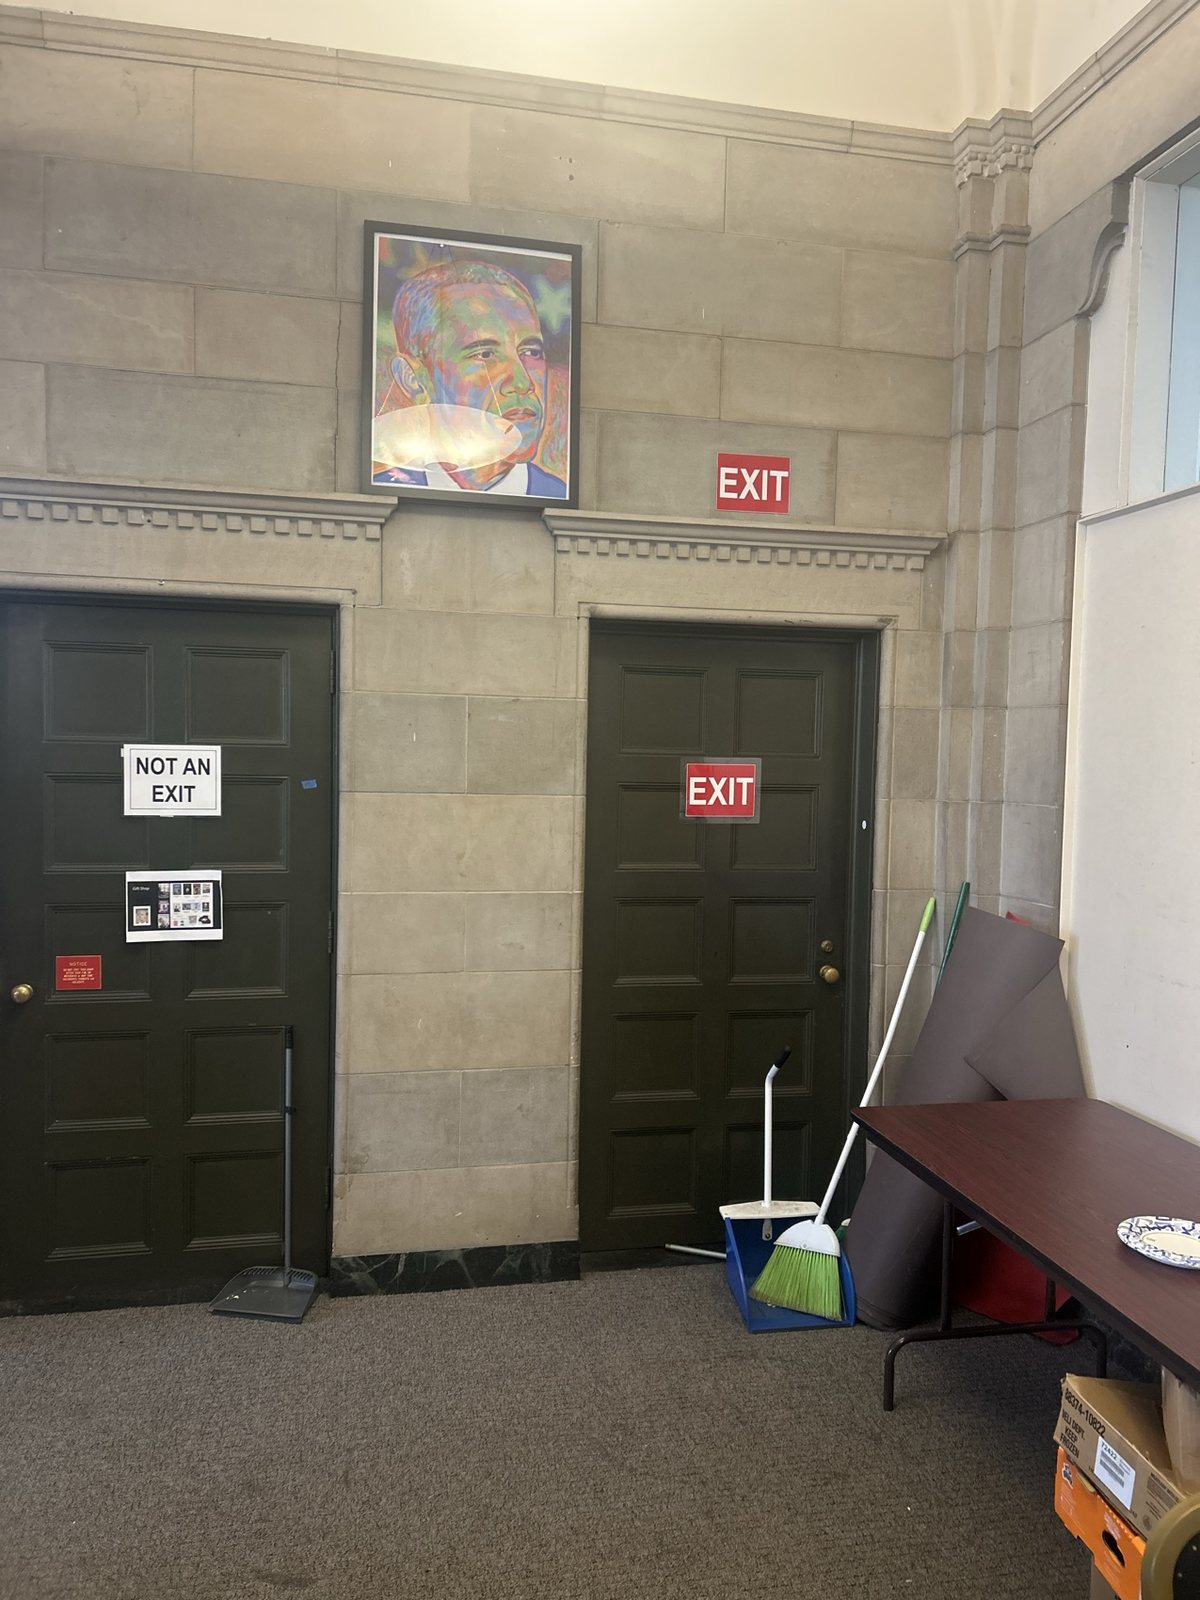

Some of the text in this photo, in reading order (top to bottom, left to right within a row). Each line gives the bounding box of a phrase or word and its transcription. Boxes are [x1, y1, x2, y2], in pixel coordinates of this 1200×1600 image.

[719, 466, 789, 502] EXIT
[136, 757, 211, 776] NOT AN
[152, 785, 196, 803] EXIT
[689, 777, 754, 806] EXIT
[1060, 1432, 1080, 1459] FROZEN
